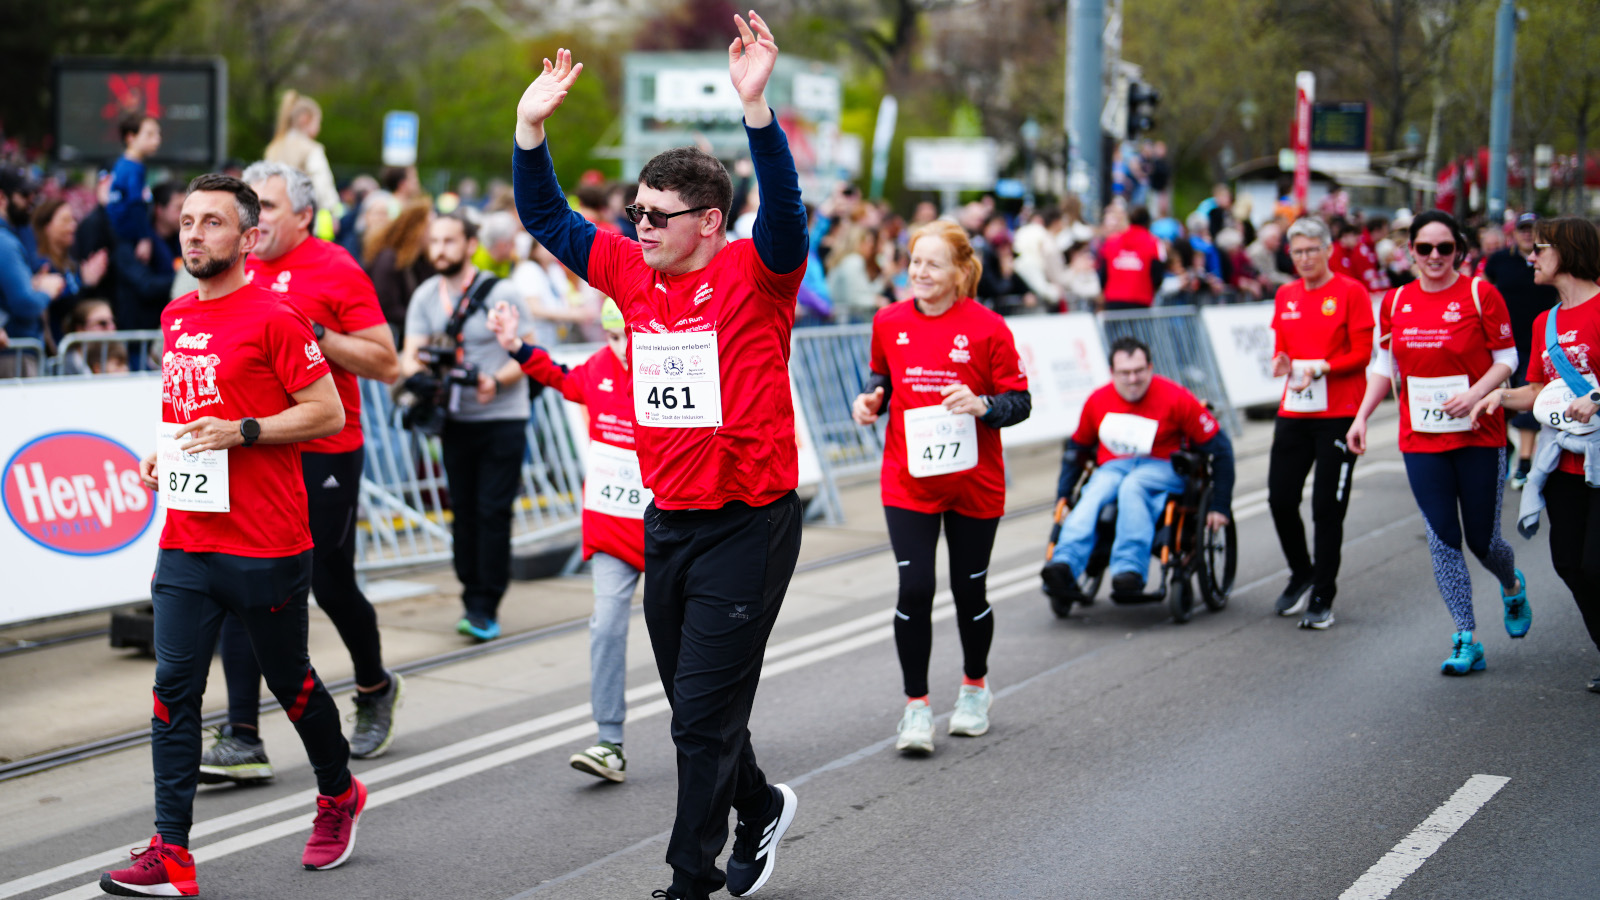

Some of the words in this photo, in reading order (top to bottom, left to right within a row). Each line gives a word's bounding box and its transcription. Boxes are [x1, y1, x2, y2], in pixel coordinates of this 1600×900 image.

[689, 316, 703, 324] Run
[682, 343, 711, 351] erleben!
[647, 386, 696, 410] 461
[923, 442, 961, 460] 477
[169, 471, 208, 494] 872
[12, 459, 148, 528] Hervis
[601, 484, 641, 504] 478
